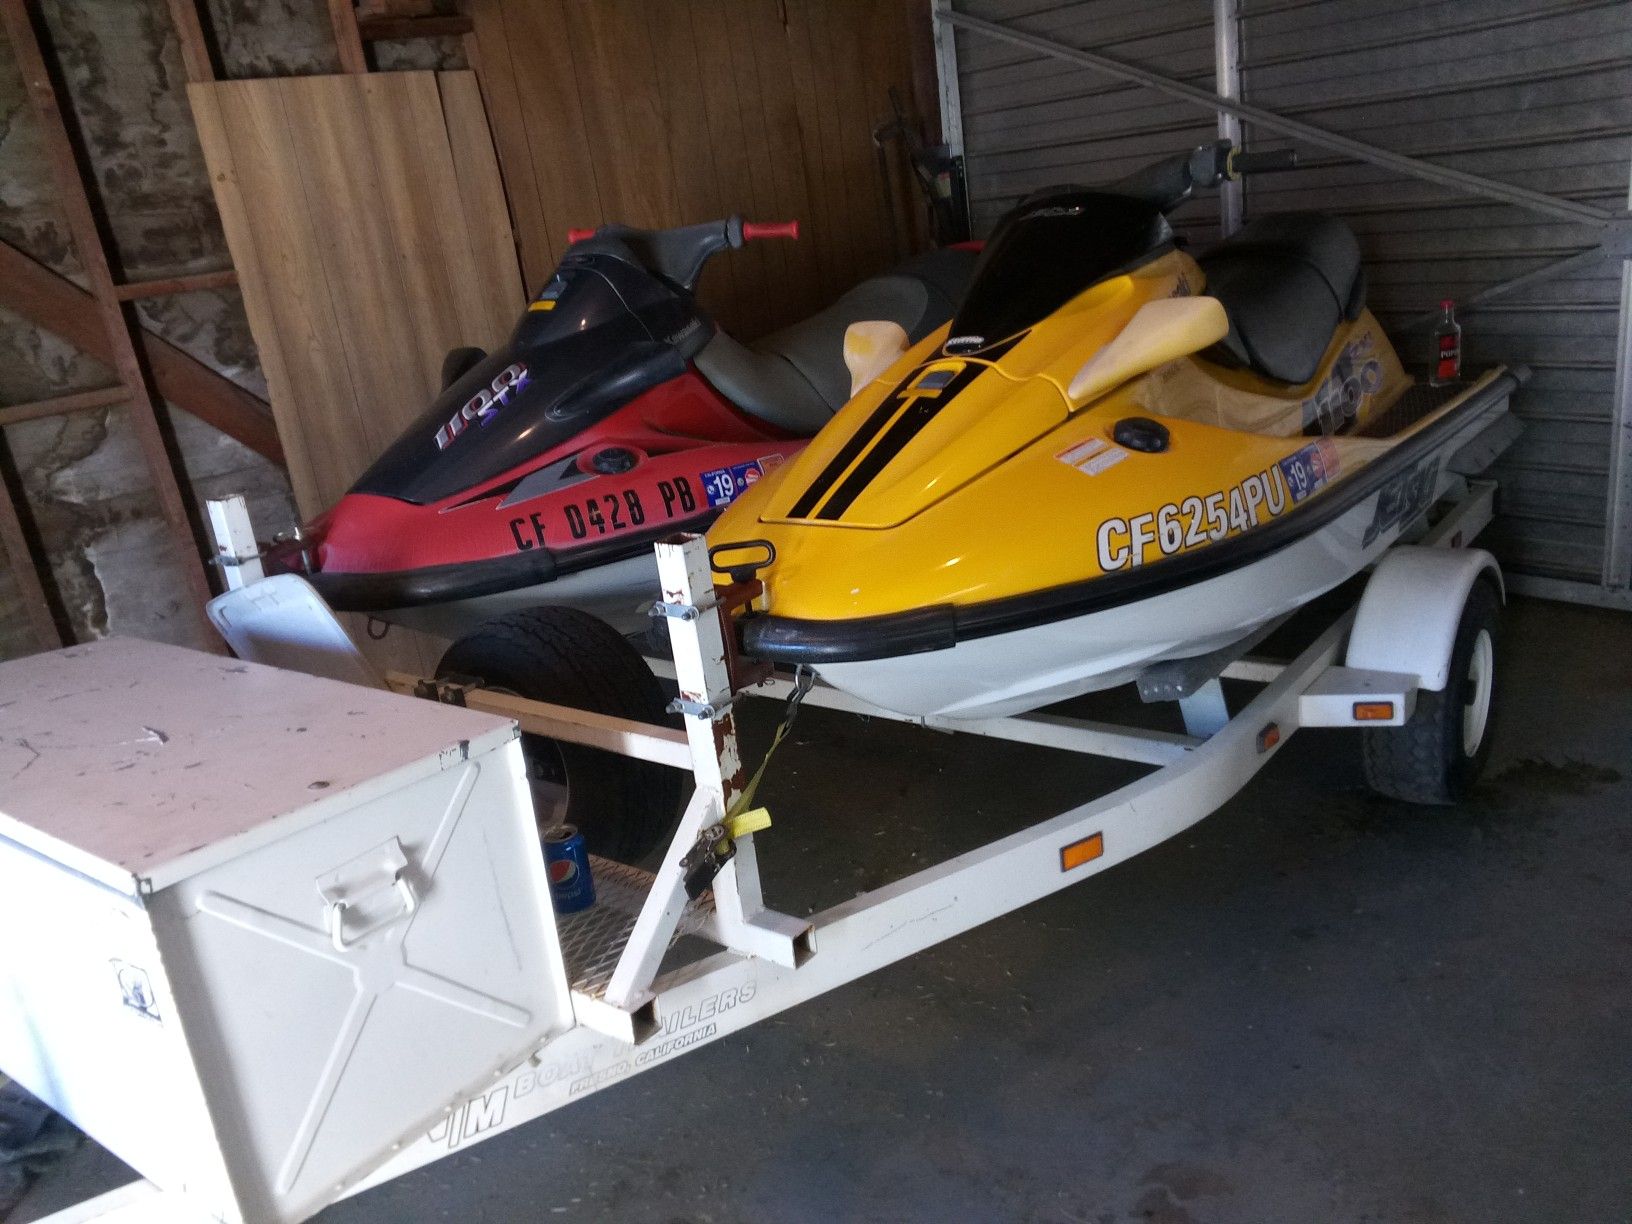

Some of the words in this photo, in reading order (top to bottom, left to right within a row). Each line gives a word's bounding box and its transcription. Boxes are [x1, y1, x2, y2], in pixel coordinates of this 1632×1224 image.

[434, 361, 528, 451] 1100
[713, 473, 734, 499] 19
[1290, 461, 1307, 490] 19
[509, 512, 546, 551] CF
[563, 488, 645, 540] 0428
[657, 475, 697, 519] PB
[635, 1021, 718, 1067] CALIFORNIA
